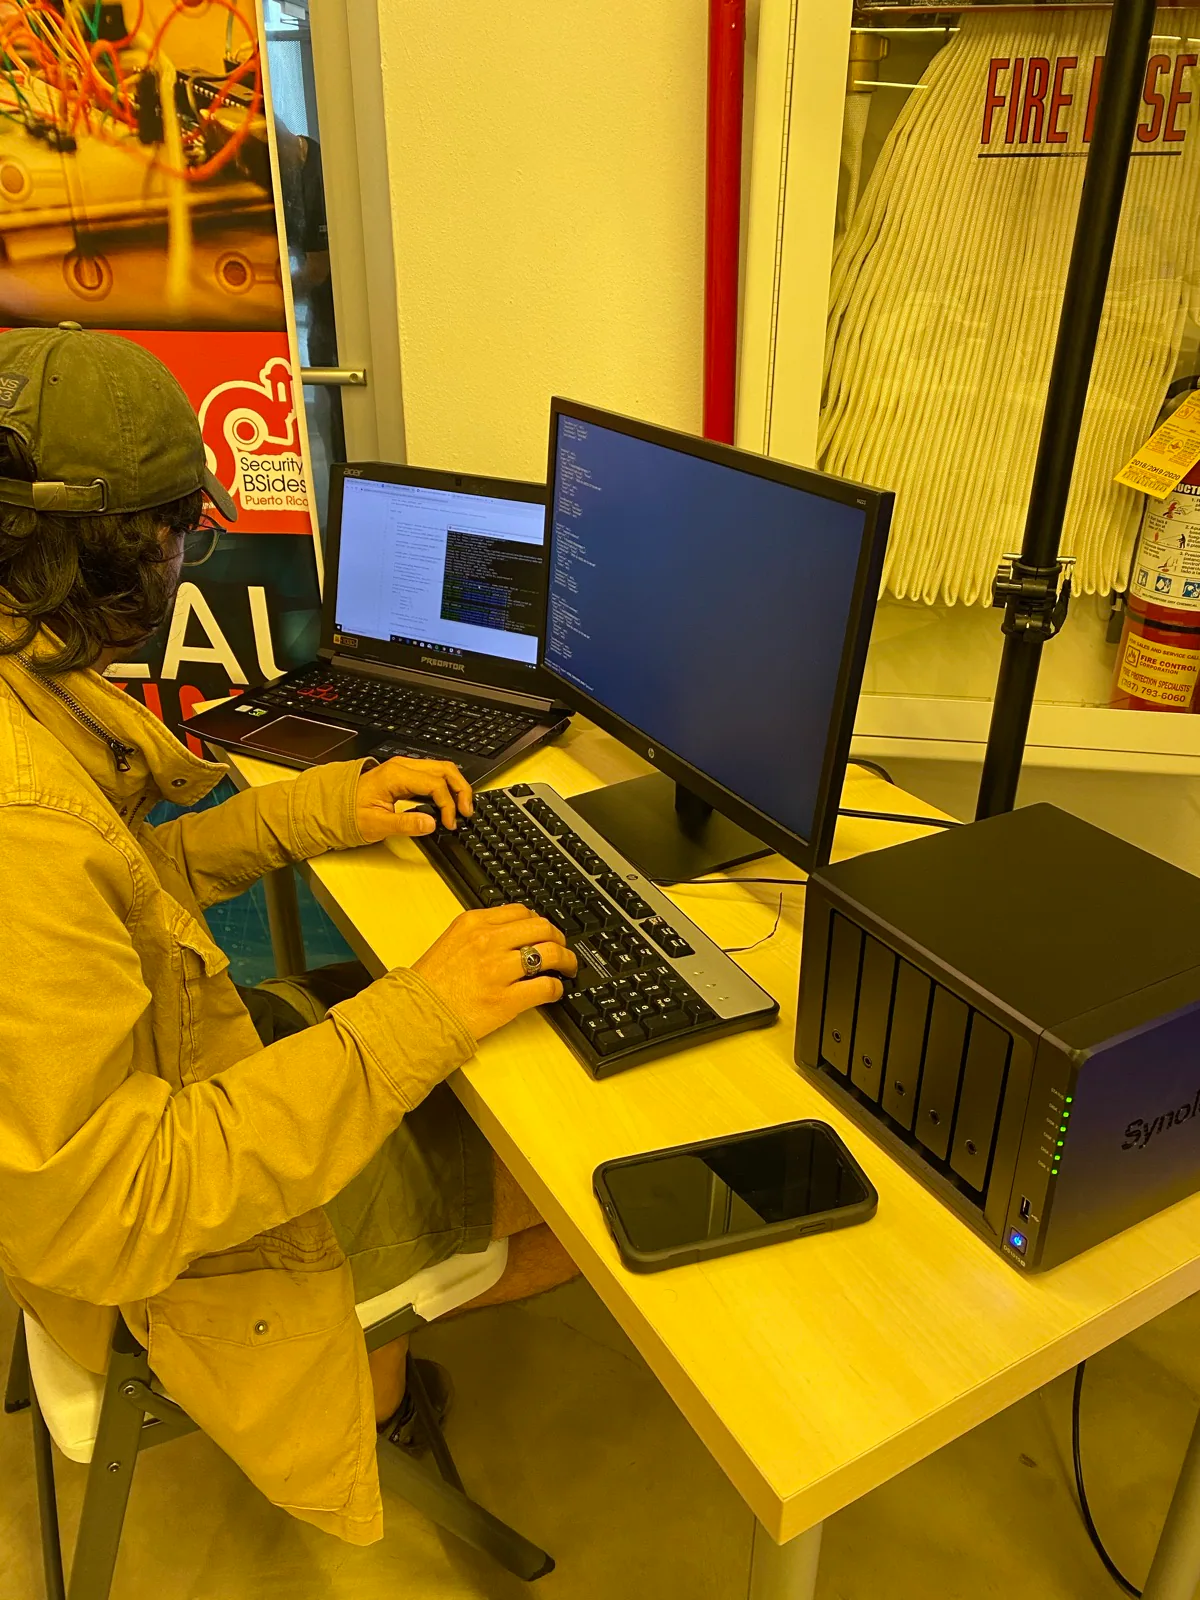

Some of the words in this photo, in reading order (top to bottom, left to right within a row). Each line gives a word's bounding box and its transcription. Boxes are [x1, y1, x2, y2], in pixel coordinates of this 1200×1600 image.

[981, 56, 1079, 144] FIRE
[1082, 54, 1199, 143] SE
[240, 456, 303, 475] Security
[243, 474, 307, 493] BSides
[245, 495, 283, 506] Puerto
[286, 495, 309, 507] Rico
[1140, 654, 1157, 665] FIRE
[1159, 660, 1197, 672] CONTROL
[1163, 650, 1186, 659] SERVICE
[421, 656, 465, 673] PREDATOR
[1140, 661, 1178, 675] CORPORATION
[1141, 686, 1186, 702] 793-6060
